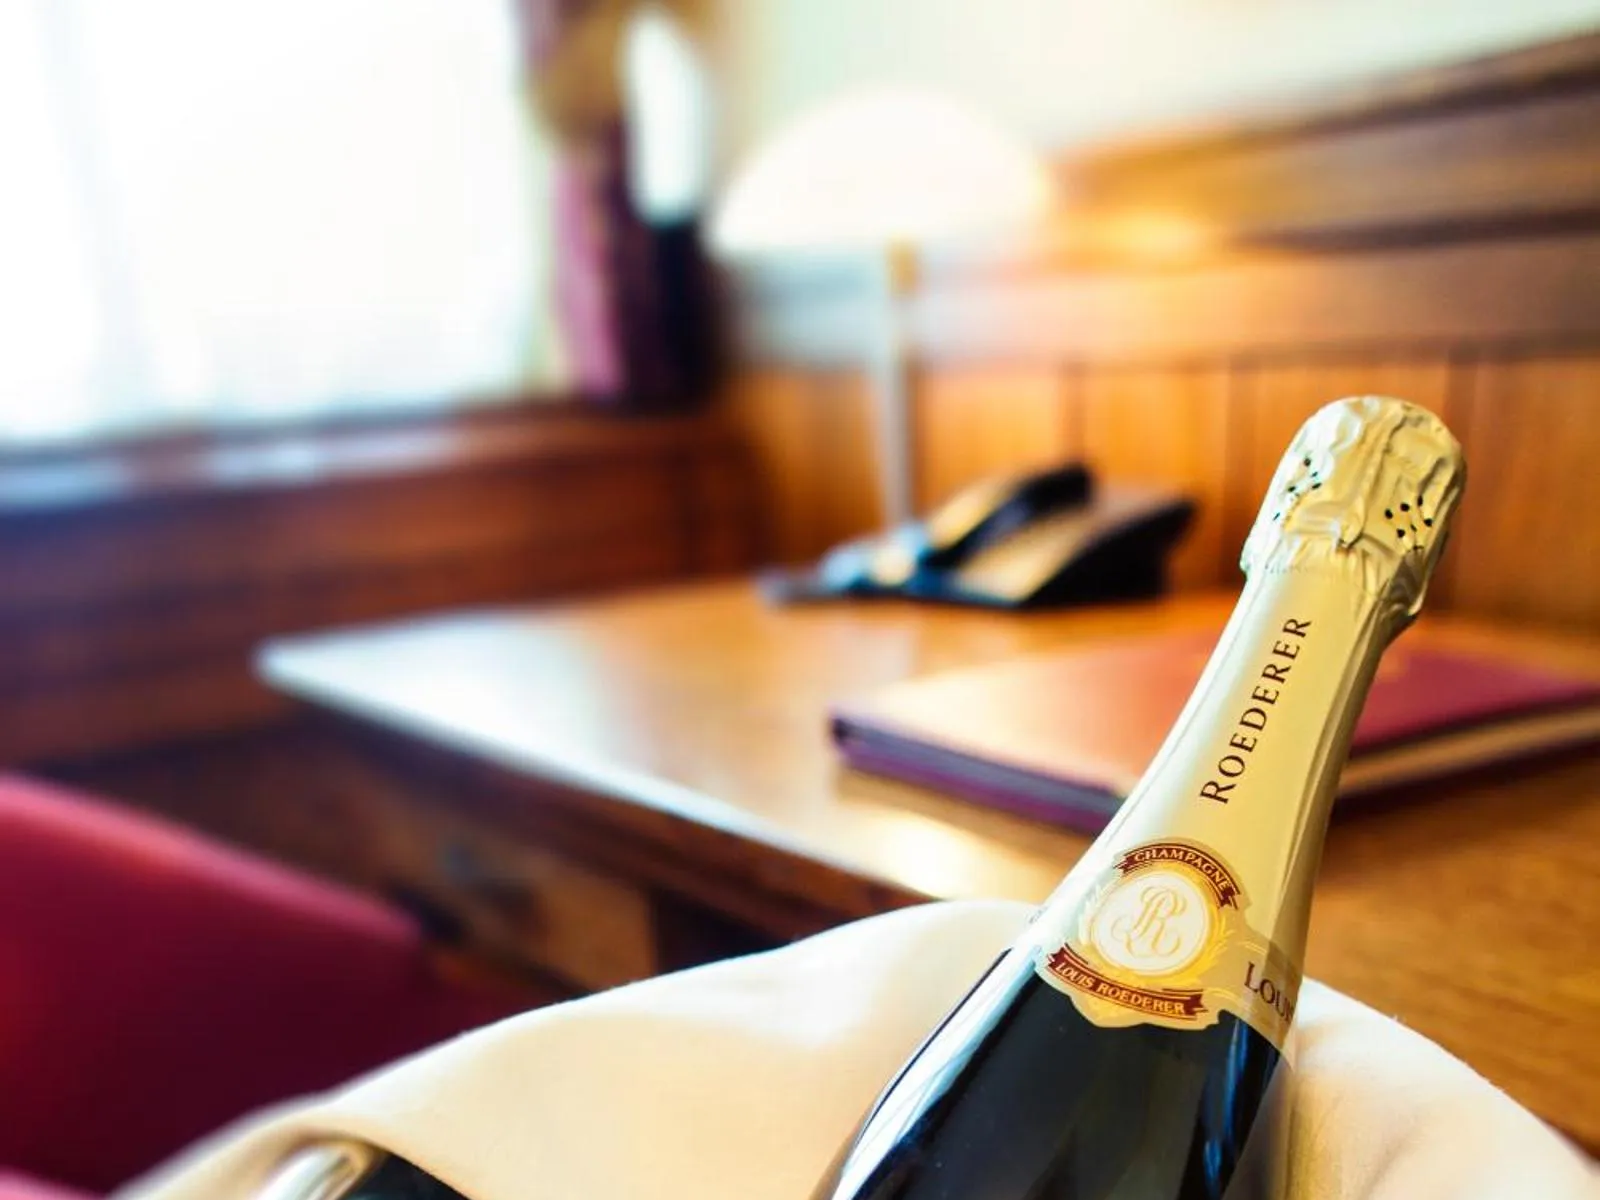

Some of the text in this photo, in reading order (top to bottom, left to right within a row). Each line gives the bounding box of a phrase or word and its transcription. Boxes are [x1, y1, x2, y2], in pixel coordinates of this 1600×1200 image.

[1199, 617, 1313, 805] ROEDERER
[1134, 847, 1231, 891] CHAMPAGNE
[1056, 962, 1186, 1015] LOUIS ROEDERER
